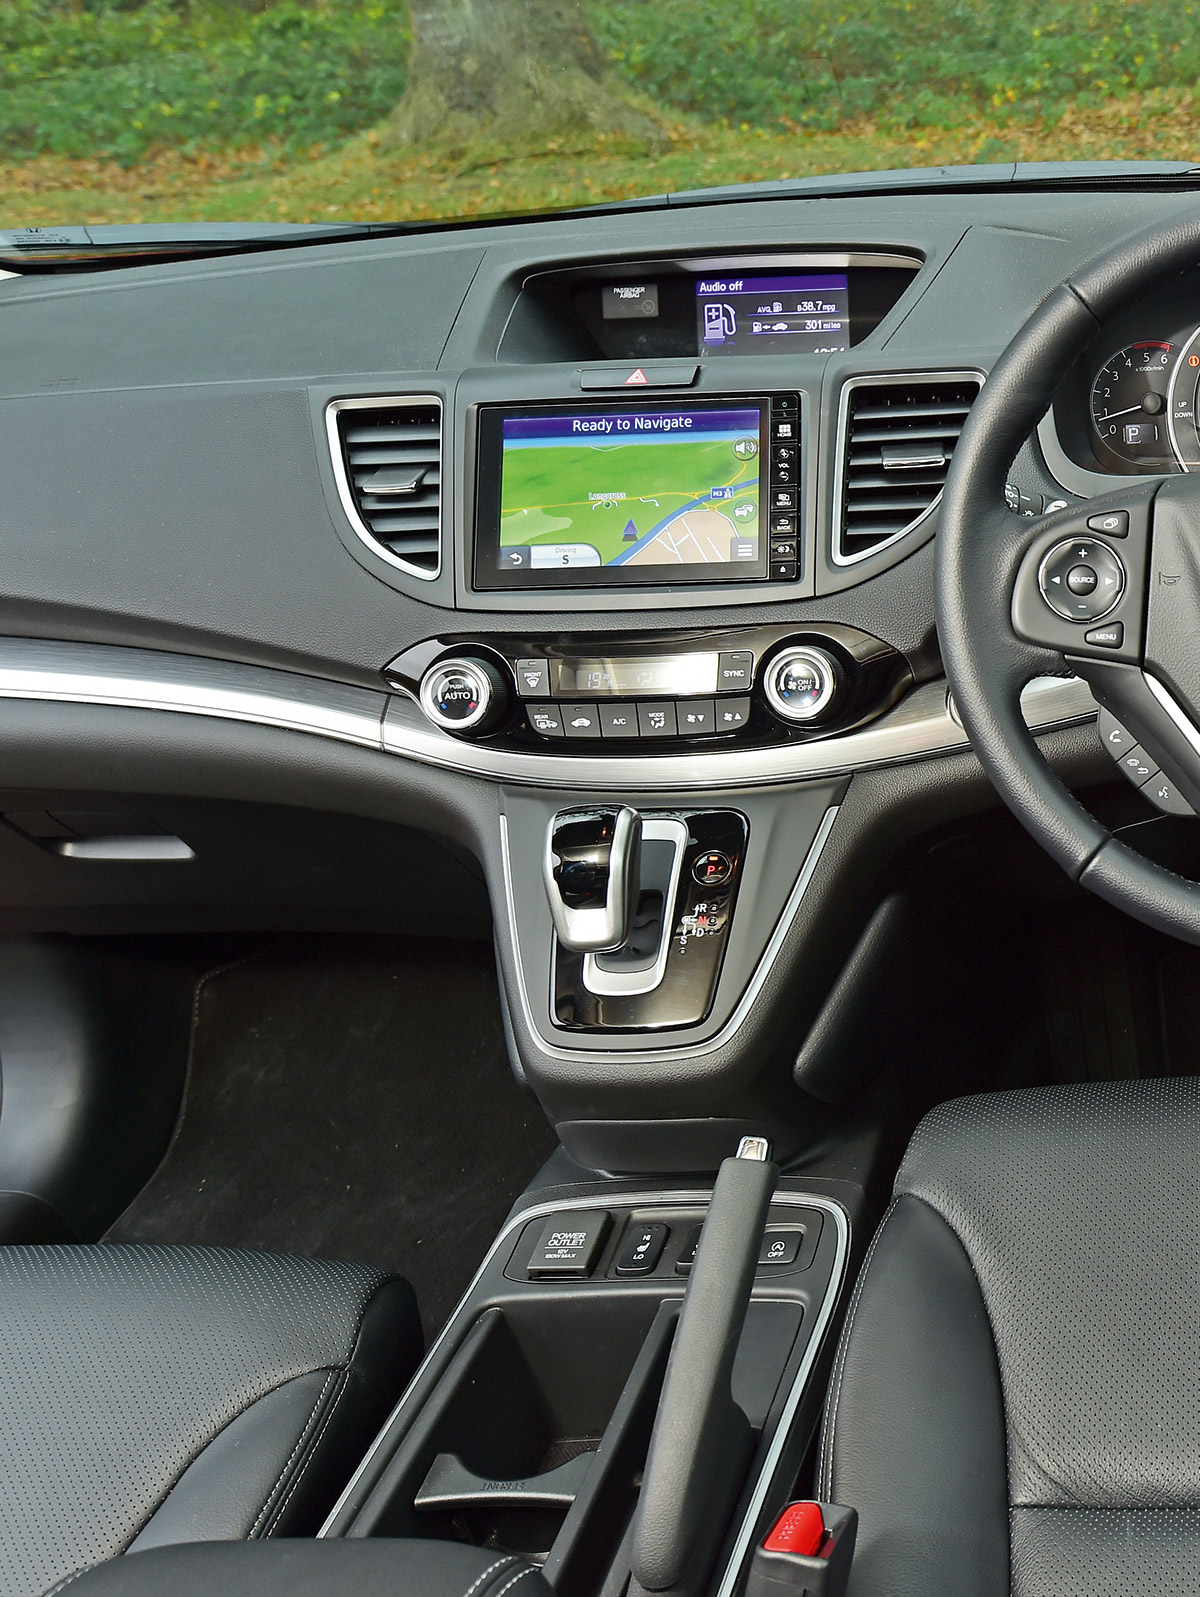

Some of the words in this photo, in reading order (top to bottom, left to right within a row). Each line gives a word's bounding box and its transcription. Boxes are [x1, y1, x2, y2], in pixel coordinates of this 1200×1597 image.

[700, 282, 726, 293] Audio
[729, 281, 743, 291] off
[805, 320, 822, 330] 301
[1143, 352, 1150, 362] 5
[1161, 354, 1168, 364] 6
[1125, 359, 1132, 367] 4
[1113, 371, 1119, 381] 3
[1104, 388, 1111, 398] 2
[1103, 408, 1108, 417] 1
[573, 419, 613, 433] Ready
[617, 419, 630, 430] to
[634, 416, 692, 431] Navigate
[1109, 425, 1117, 435] 0
[1128, 428, 1139, 442] P
[589, 492, 626, 501] Longcross
[1070, 576, 1095, 584] SOURCE
[1095, 633, 1116, 641] MENU
[444, 691, 471, 700] AUTO
[707, 865, 716, 876] P
[699, 903, 708, 912] R
[698, 916, 707, 924] N
[696, 928, 705, 937] D
[680, 936, 688, 945] S
[552, 1232, 587, 1240] POWER
